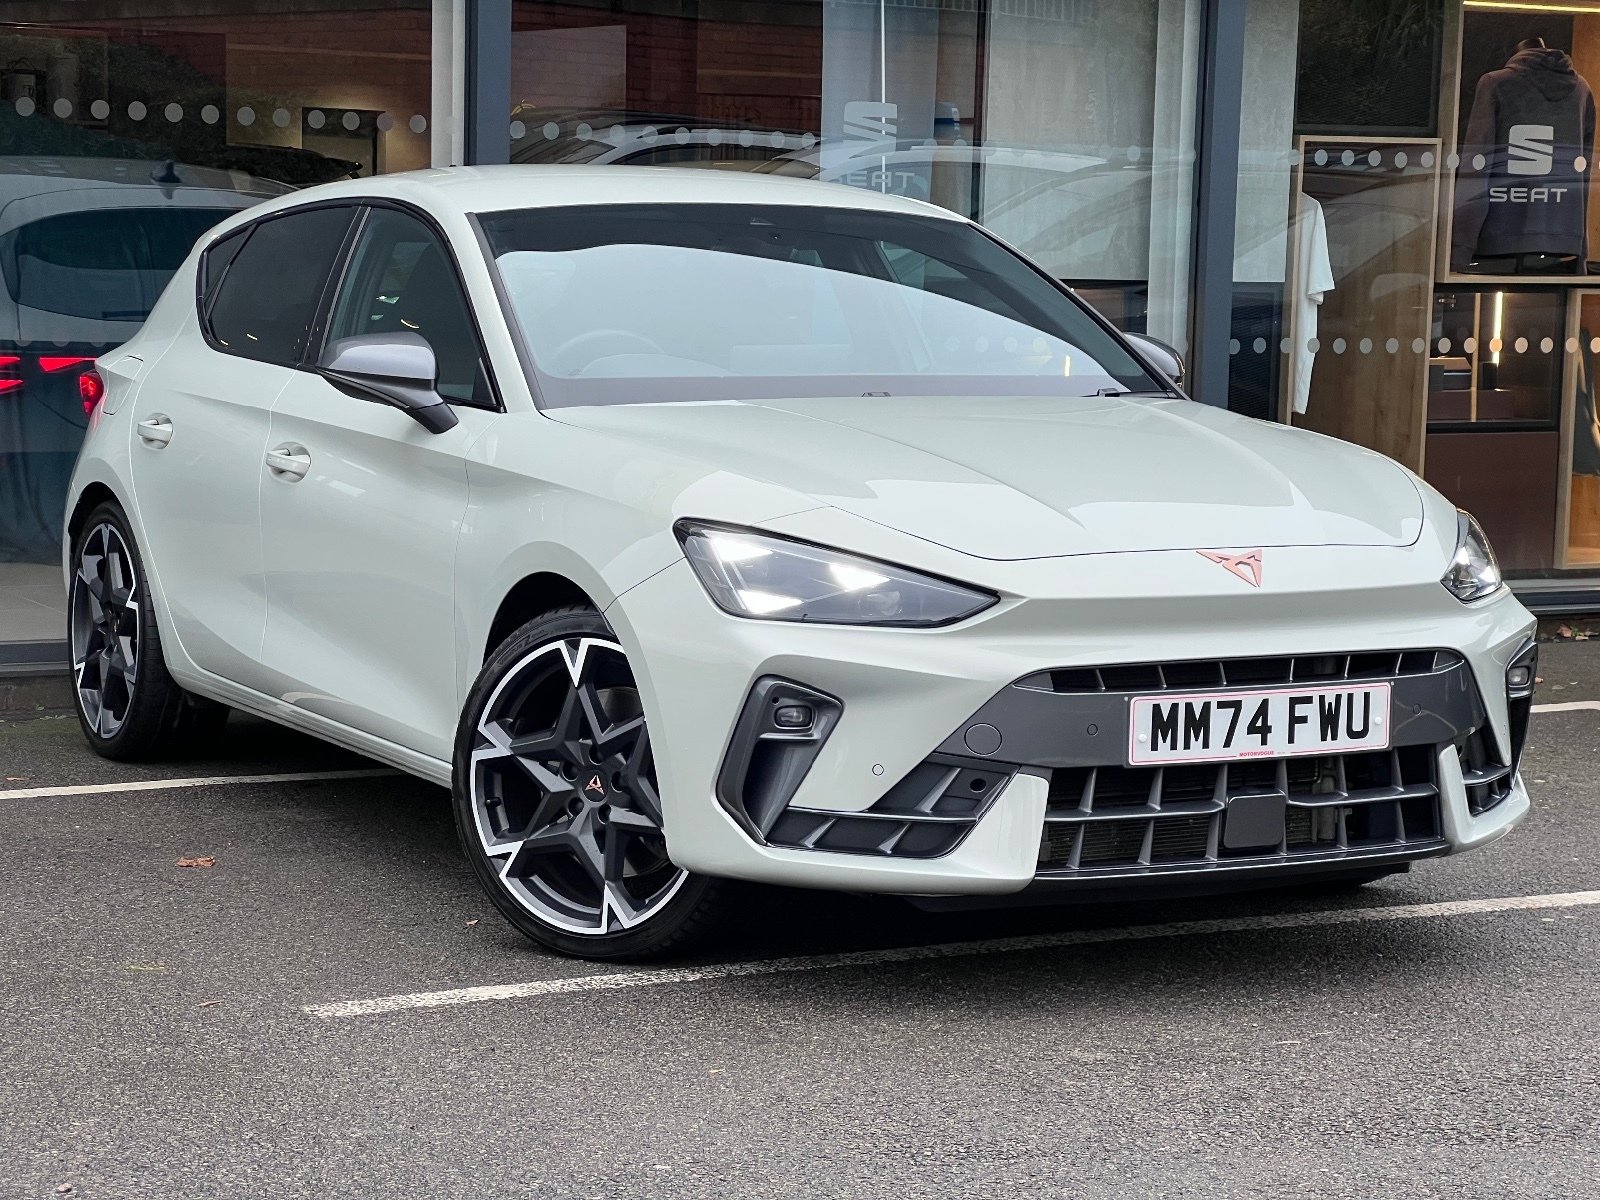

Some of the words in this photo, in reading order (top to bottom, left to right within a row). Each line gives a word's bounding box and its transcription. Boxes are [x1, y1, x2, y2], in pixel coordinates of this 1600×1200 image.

[1489, 187, 1568, 203] SEAT
[1150, 698, 1273, 752] MM74
[1287, 691, 1371, 745] FWU
